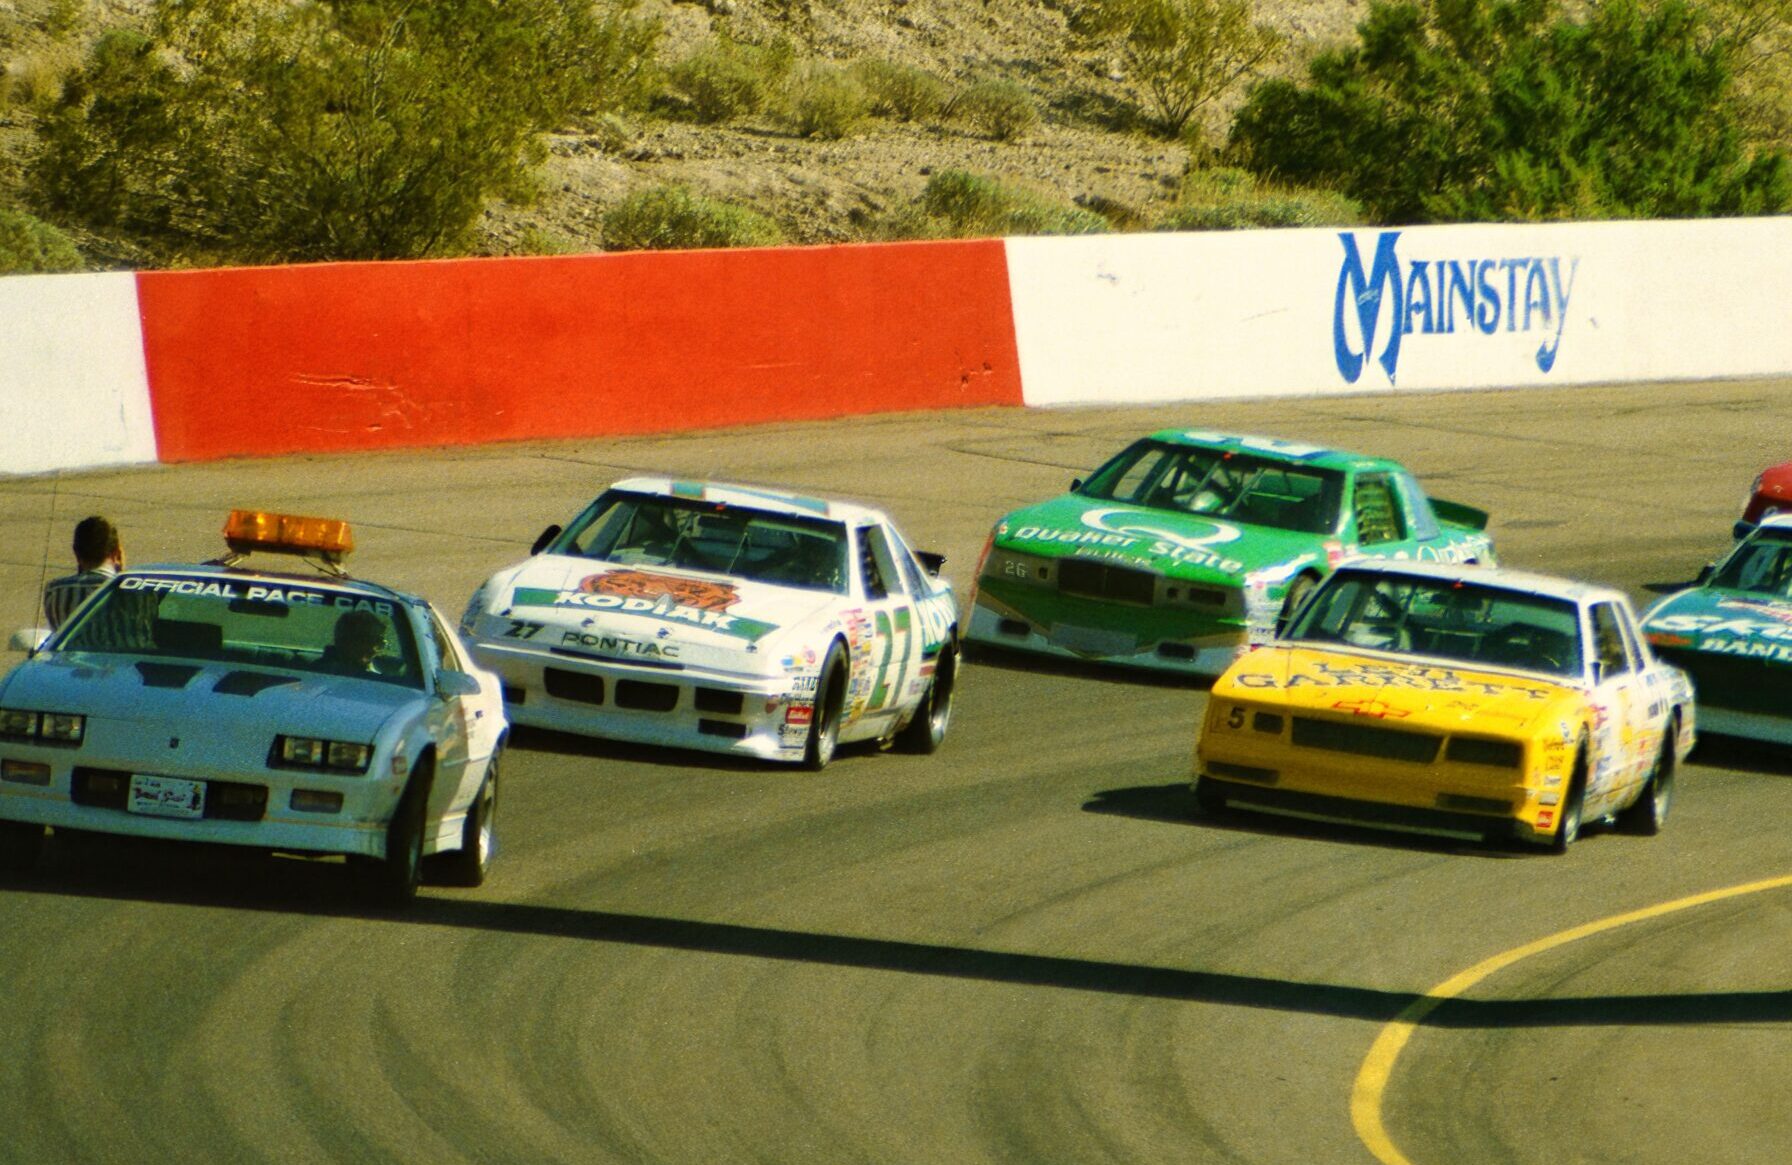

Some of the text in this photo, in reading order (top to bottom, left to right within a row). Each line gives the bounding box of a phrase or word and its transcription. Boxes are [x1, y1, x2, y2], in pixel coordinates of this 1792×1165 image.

[1148, 540, 1243, 574] State
[119, 577, 394, 617] OFFICIAL PACE CAR
[553, 591, 739, 630] KODIAK
[506, 619, 546, 639] 27
[562, 631, 680, 658] PONTIAC
[1236, 672, 1550, 699] GARRETT
[1227, 706, 1246, 730] 5
